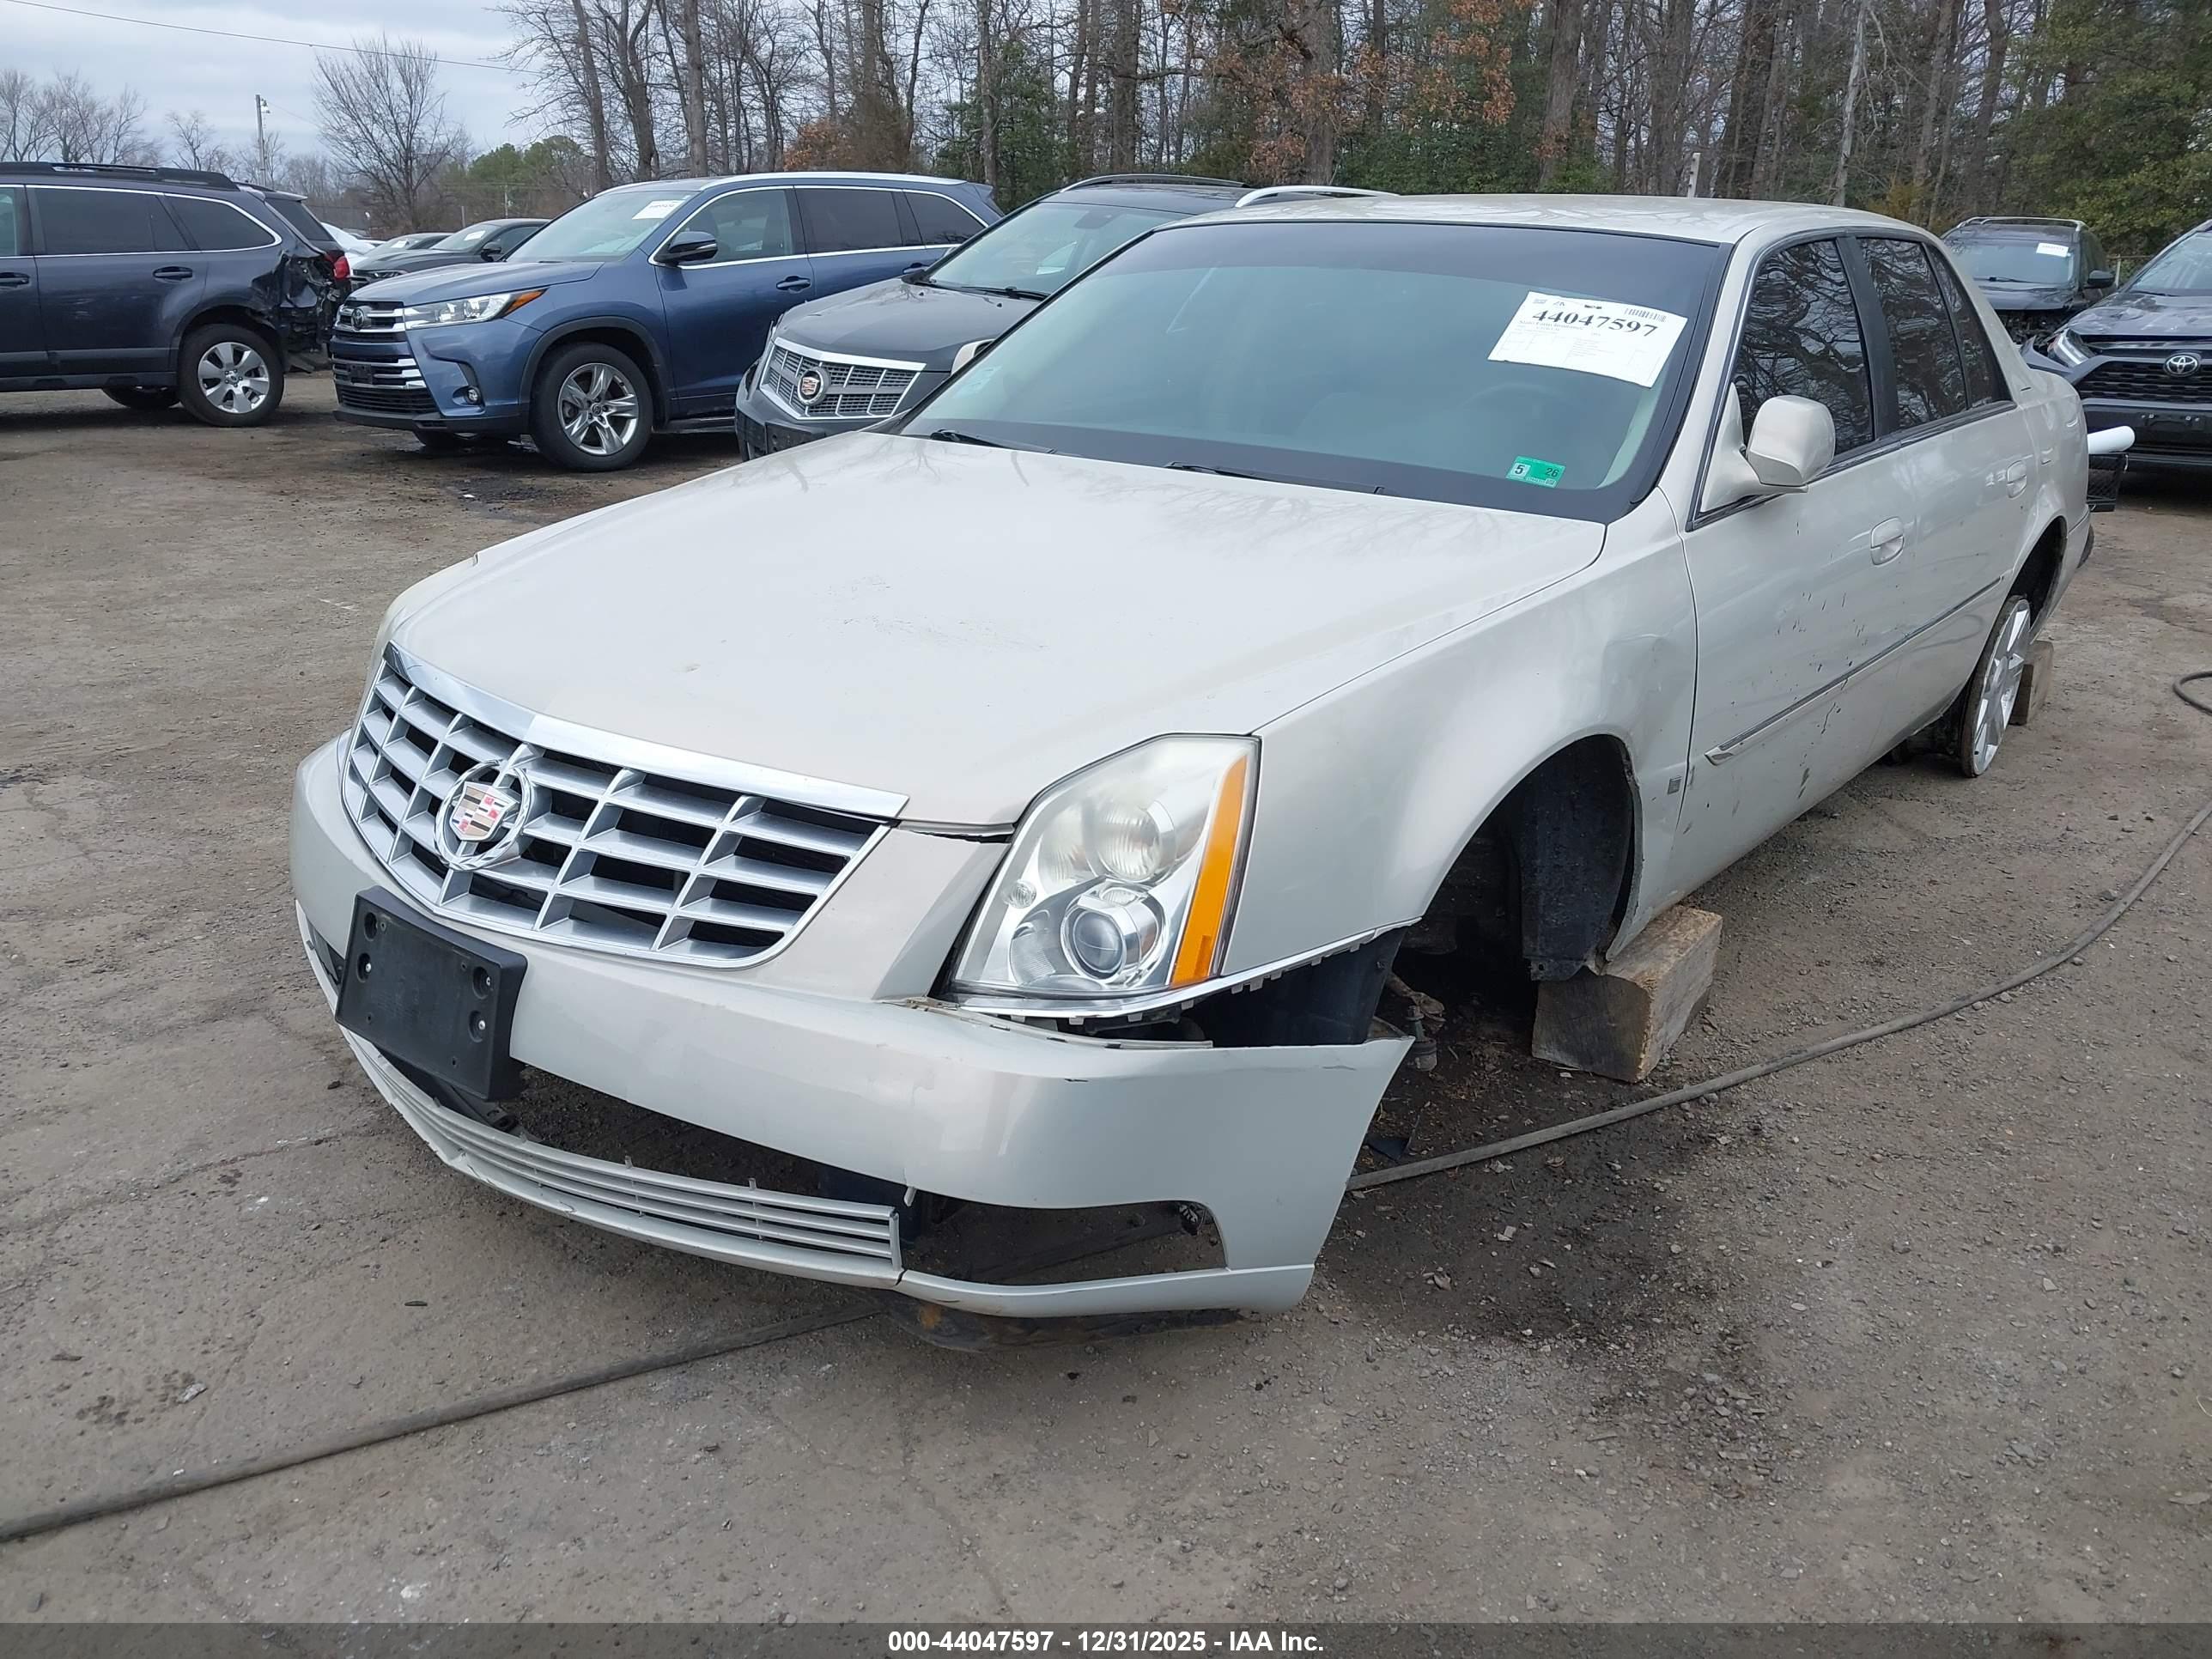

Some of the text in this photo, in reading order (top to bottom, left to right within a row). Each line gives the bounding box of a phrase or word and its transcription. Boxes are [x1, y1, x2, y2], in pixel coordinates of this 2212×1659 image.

[1532, 310, 1658, 337] 44047597
[1515, 465, 1525, 474] 5
[1546, 467, 1559, 477] 26
